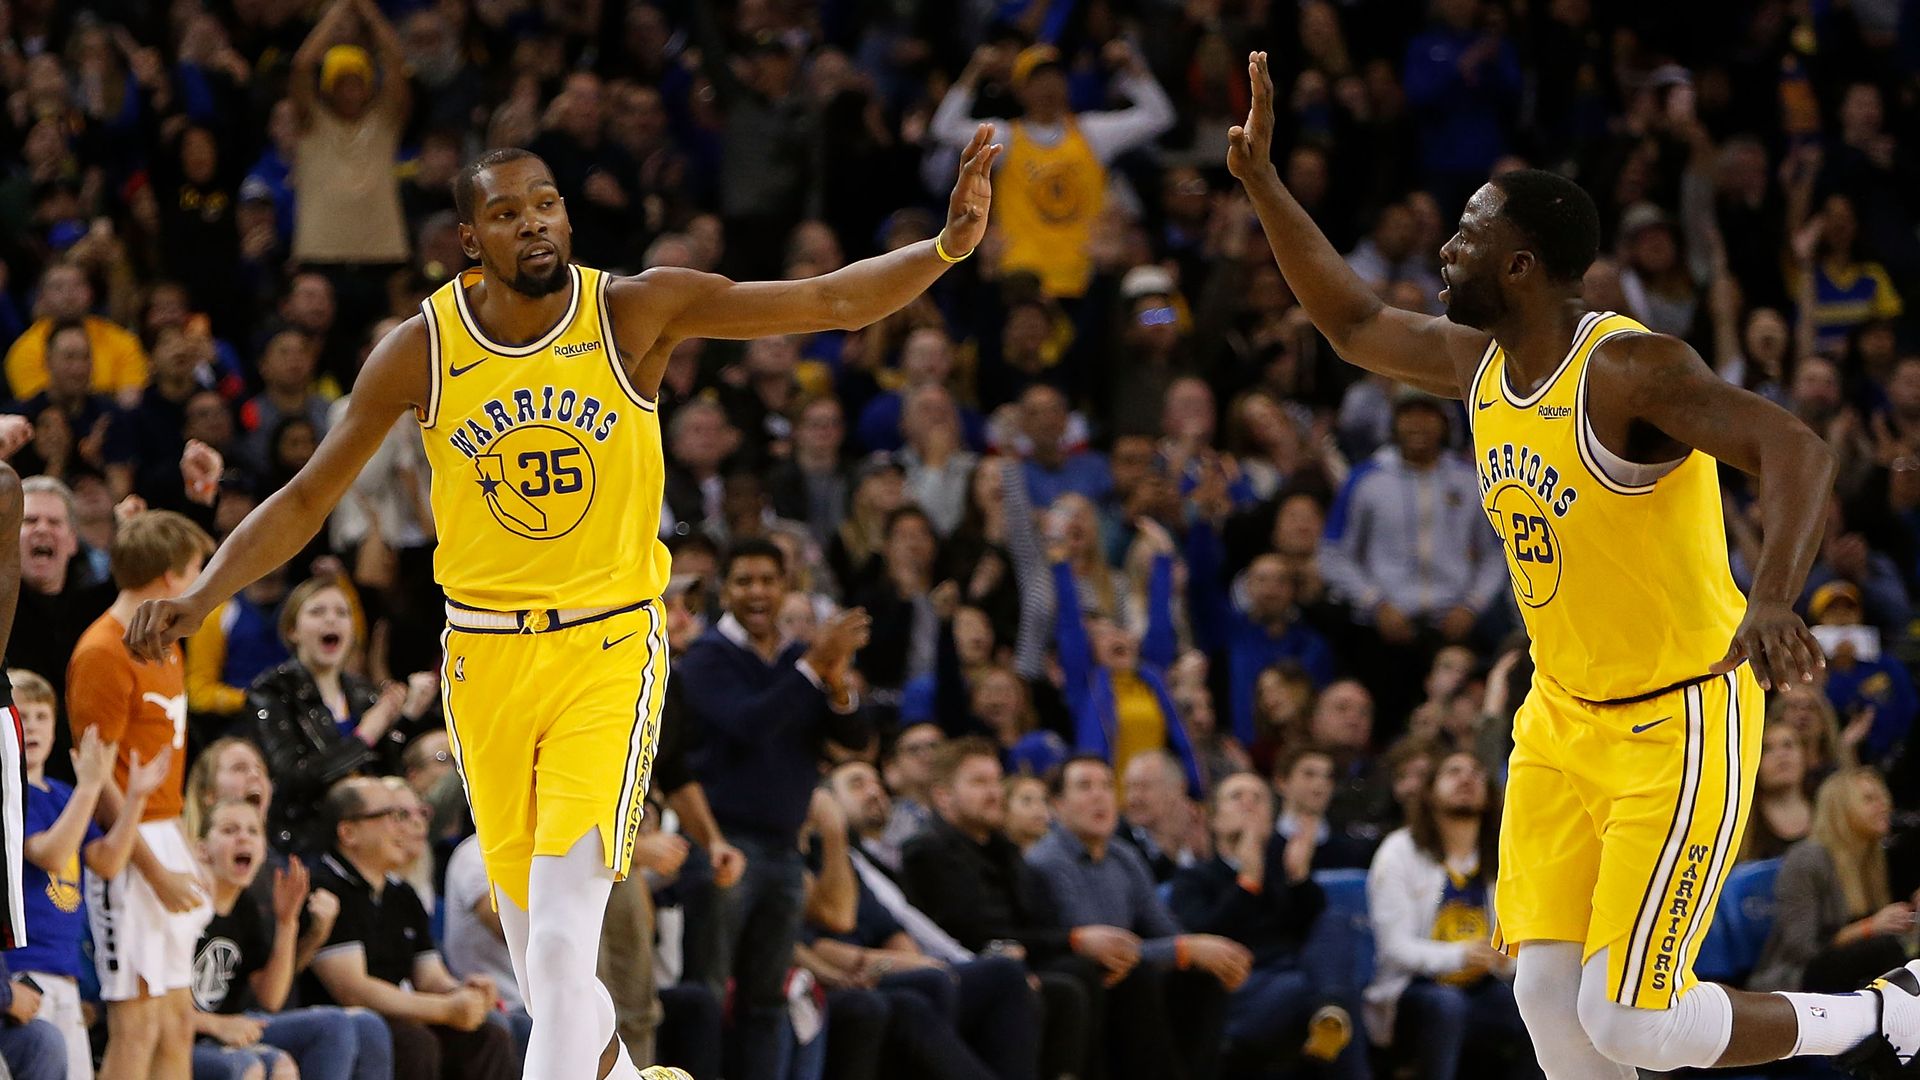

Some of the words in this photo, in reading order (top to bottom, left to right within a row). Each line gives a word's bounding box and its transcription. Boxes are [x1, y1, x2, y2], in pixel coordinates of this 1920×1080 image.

[554, 340, 601, 356] Rakuten
[450, 386, 618, 459] WARRIORS
[1538, 405, 1572, 418] Rakuten
[518, 447, 583, 497] 35
[1479, 444, 1577, 518] ARRIORS
[1512, 513, 1554, 564] 23
[1652, 844, 1709, 990] WARRIORS
